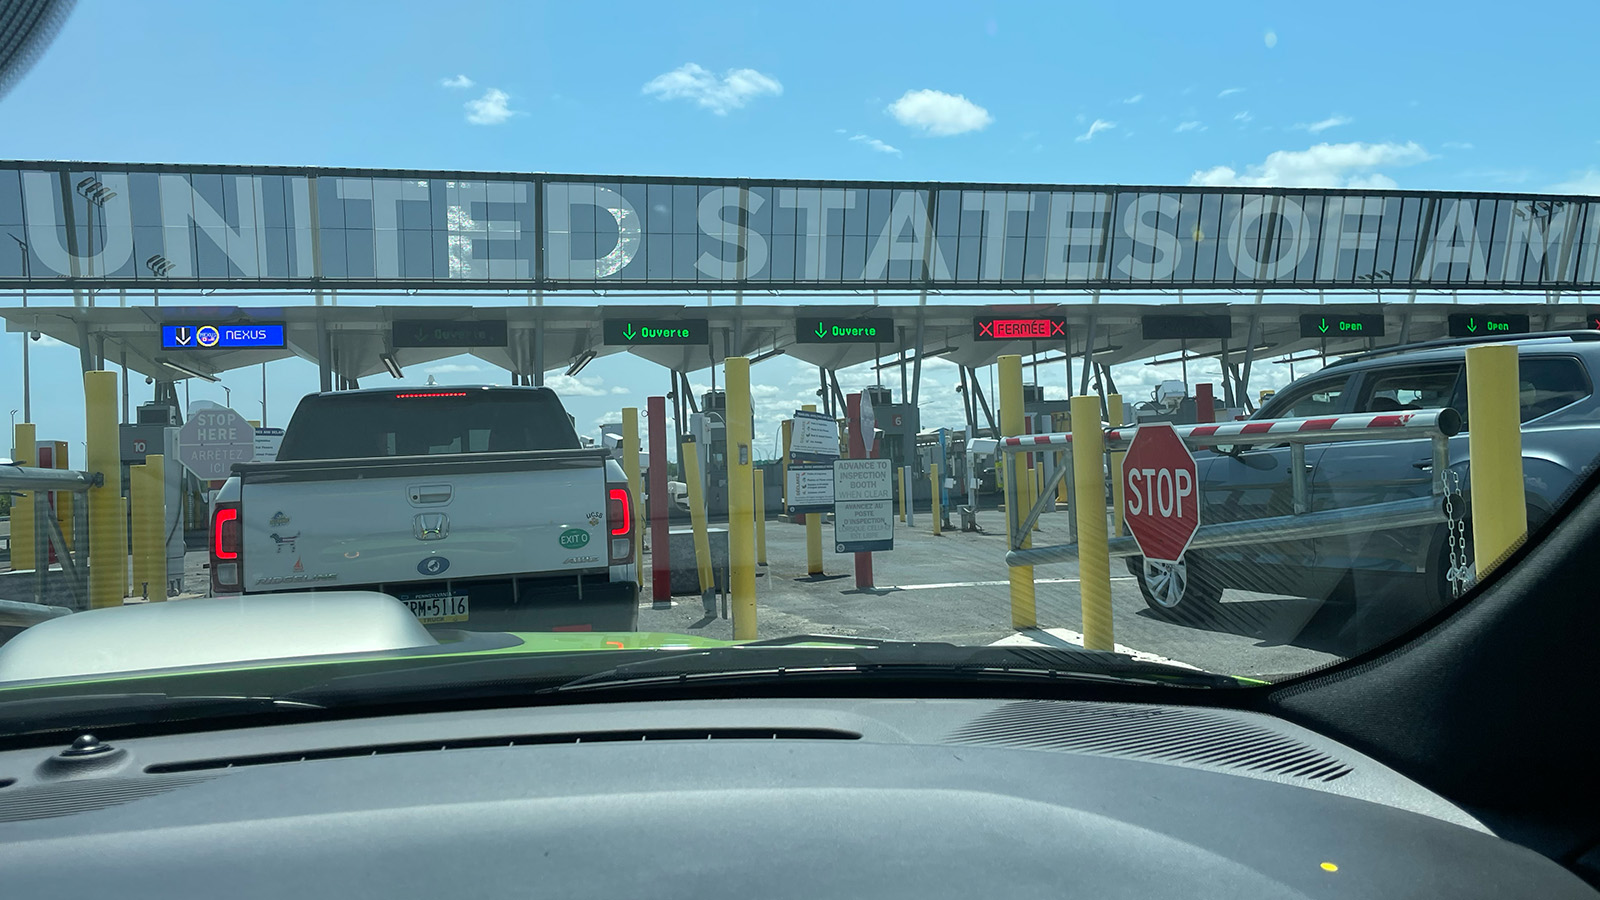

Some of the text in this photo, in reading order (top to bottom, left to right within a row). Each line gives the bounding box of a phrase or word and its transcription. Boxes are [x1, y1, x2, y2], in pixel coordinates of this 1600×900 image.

[22, 172, 641, 279] UNITED
[692, 187, 1184, 281] STATES
[1228, 195, 1386, 281] OF
[831, 325, 876, 336] Ouverte
[997, 320, 1045, 335] FERMÉE
[1339, 321, 1363, 331] Open
[1487, 321, 1509, 331] Open
[225, 330, 267, 340] NEXUS
[641, 327, 689, 338] Ouverte
[198, 413, 236, 426] STOP
[895, 416, 902, 425] 6
[197, 428, 237, 441] HERE
[134, 442, 146, 452] 10
[210, 463, 225, 473] ICI
[838, 461, 875, 469] ADVANCE
[877, 461, 887, 469] TO
[840, 471, 886, 479] INSPECTION
[839, 490, 889, 499] WHEN CLEAR
[1128, 467, 1192, 518] STOP
[560, 534, 579, 545] EXIT
